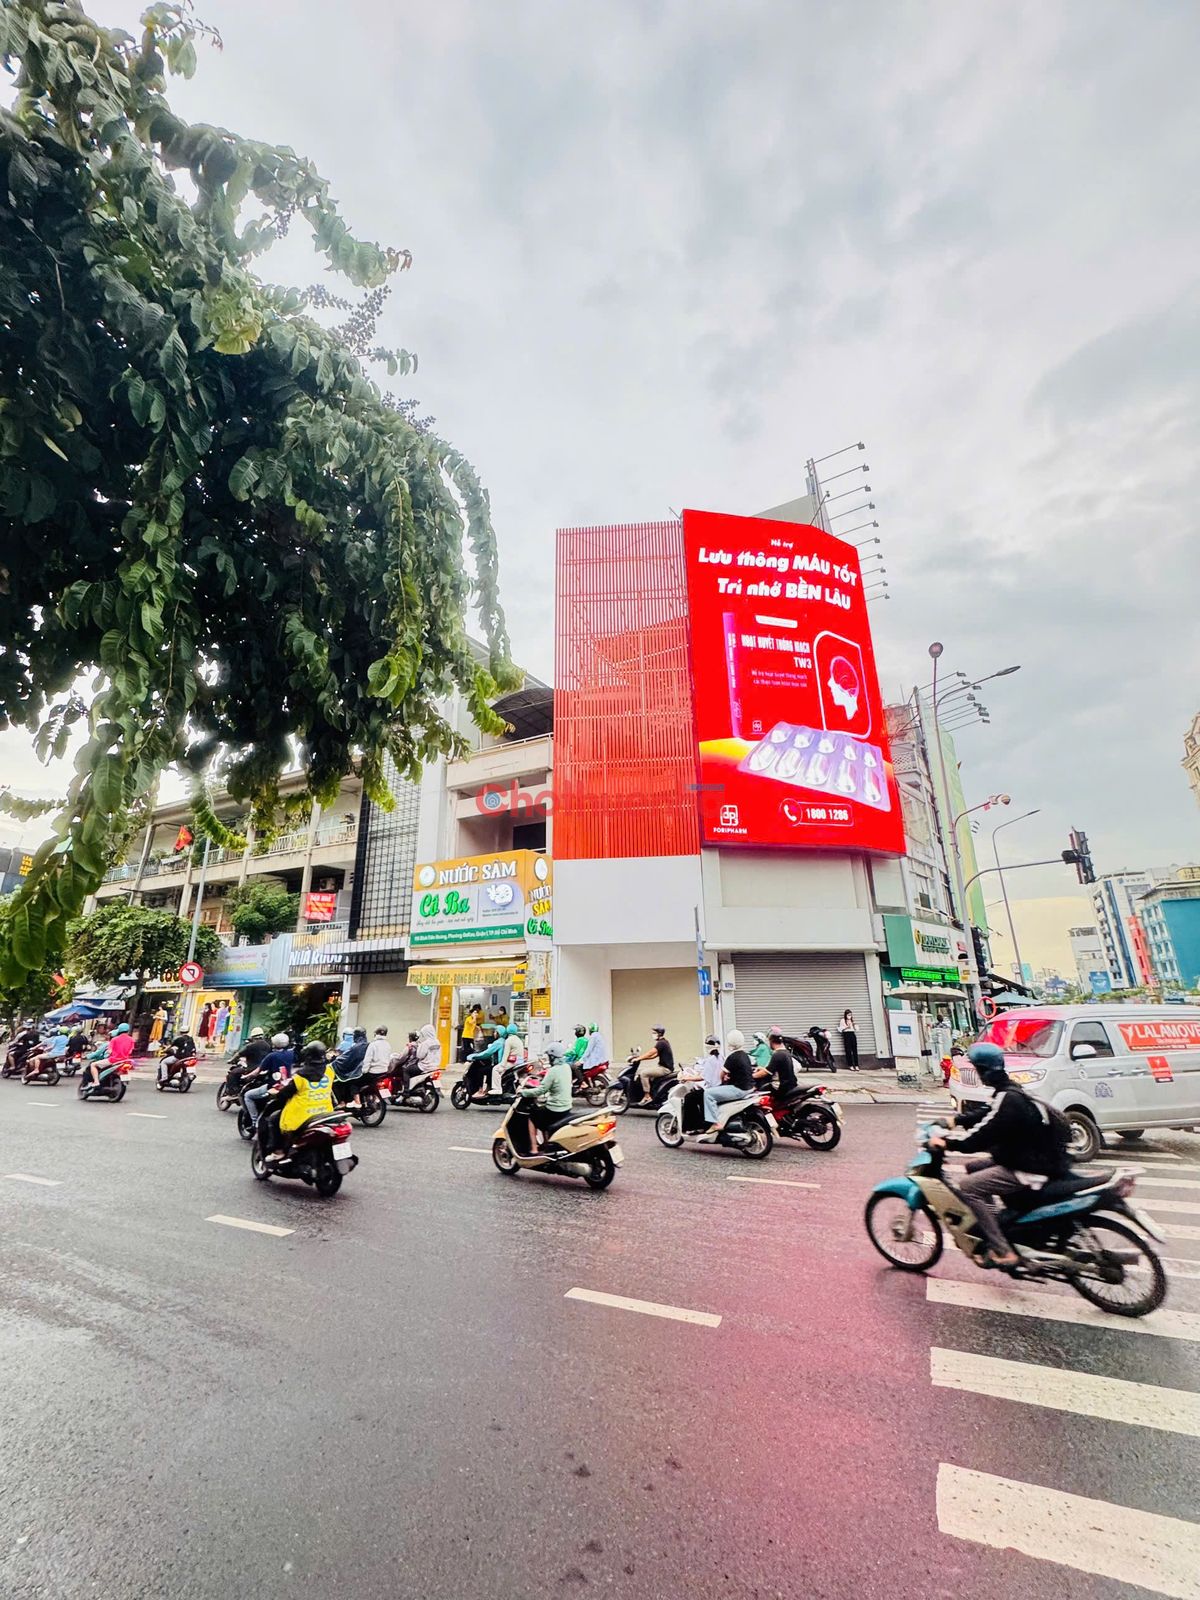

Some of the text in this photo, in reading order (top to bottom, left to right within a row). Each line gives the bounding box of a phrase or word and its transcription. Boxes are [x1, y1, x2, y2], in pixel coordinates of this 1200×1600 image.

[698, 547, 857, 586] Lưu thông MÁU TỐT
[717, 576, 851, 610] Trí nhớ BỀN LÂU
[793, 656, 812, 669] TW3
[440, 859, 517, 885] NƯỚC SÂM
[442, 891, 470, 916] Ba
[1134, 1023, 1200, 1039] LALAMOVE
